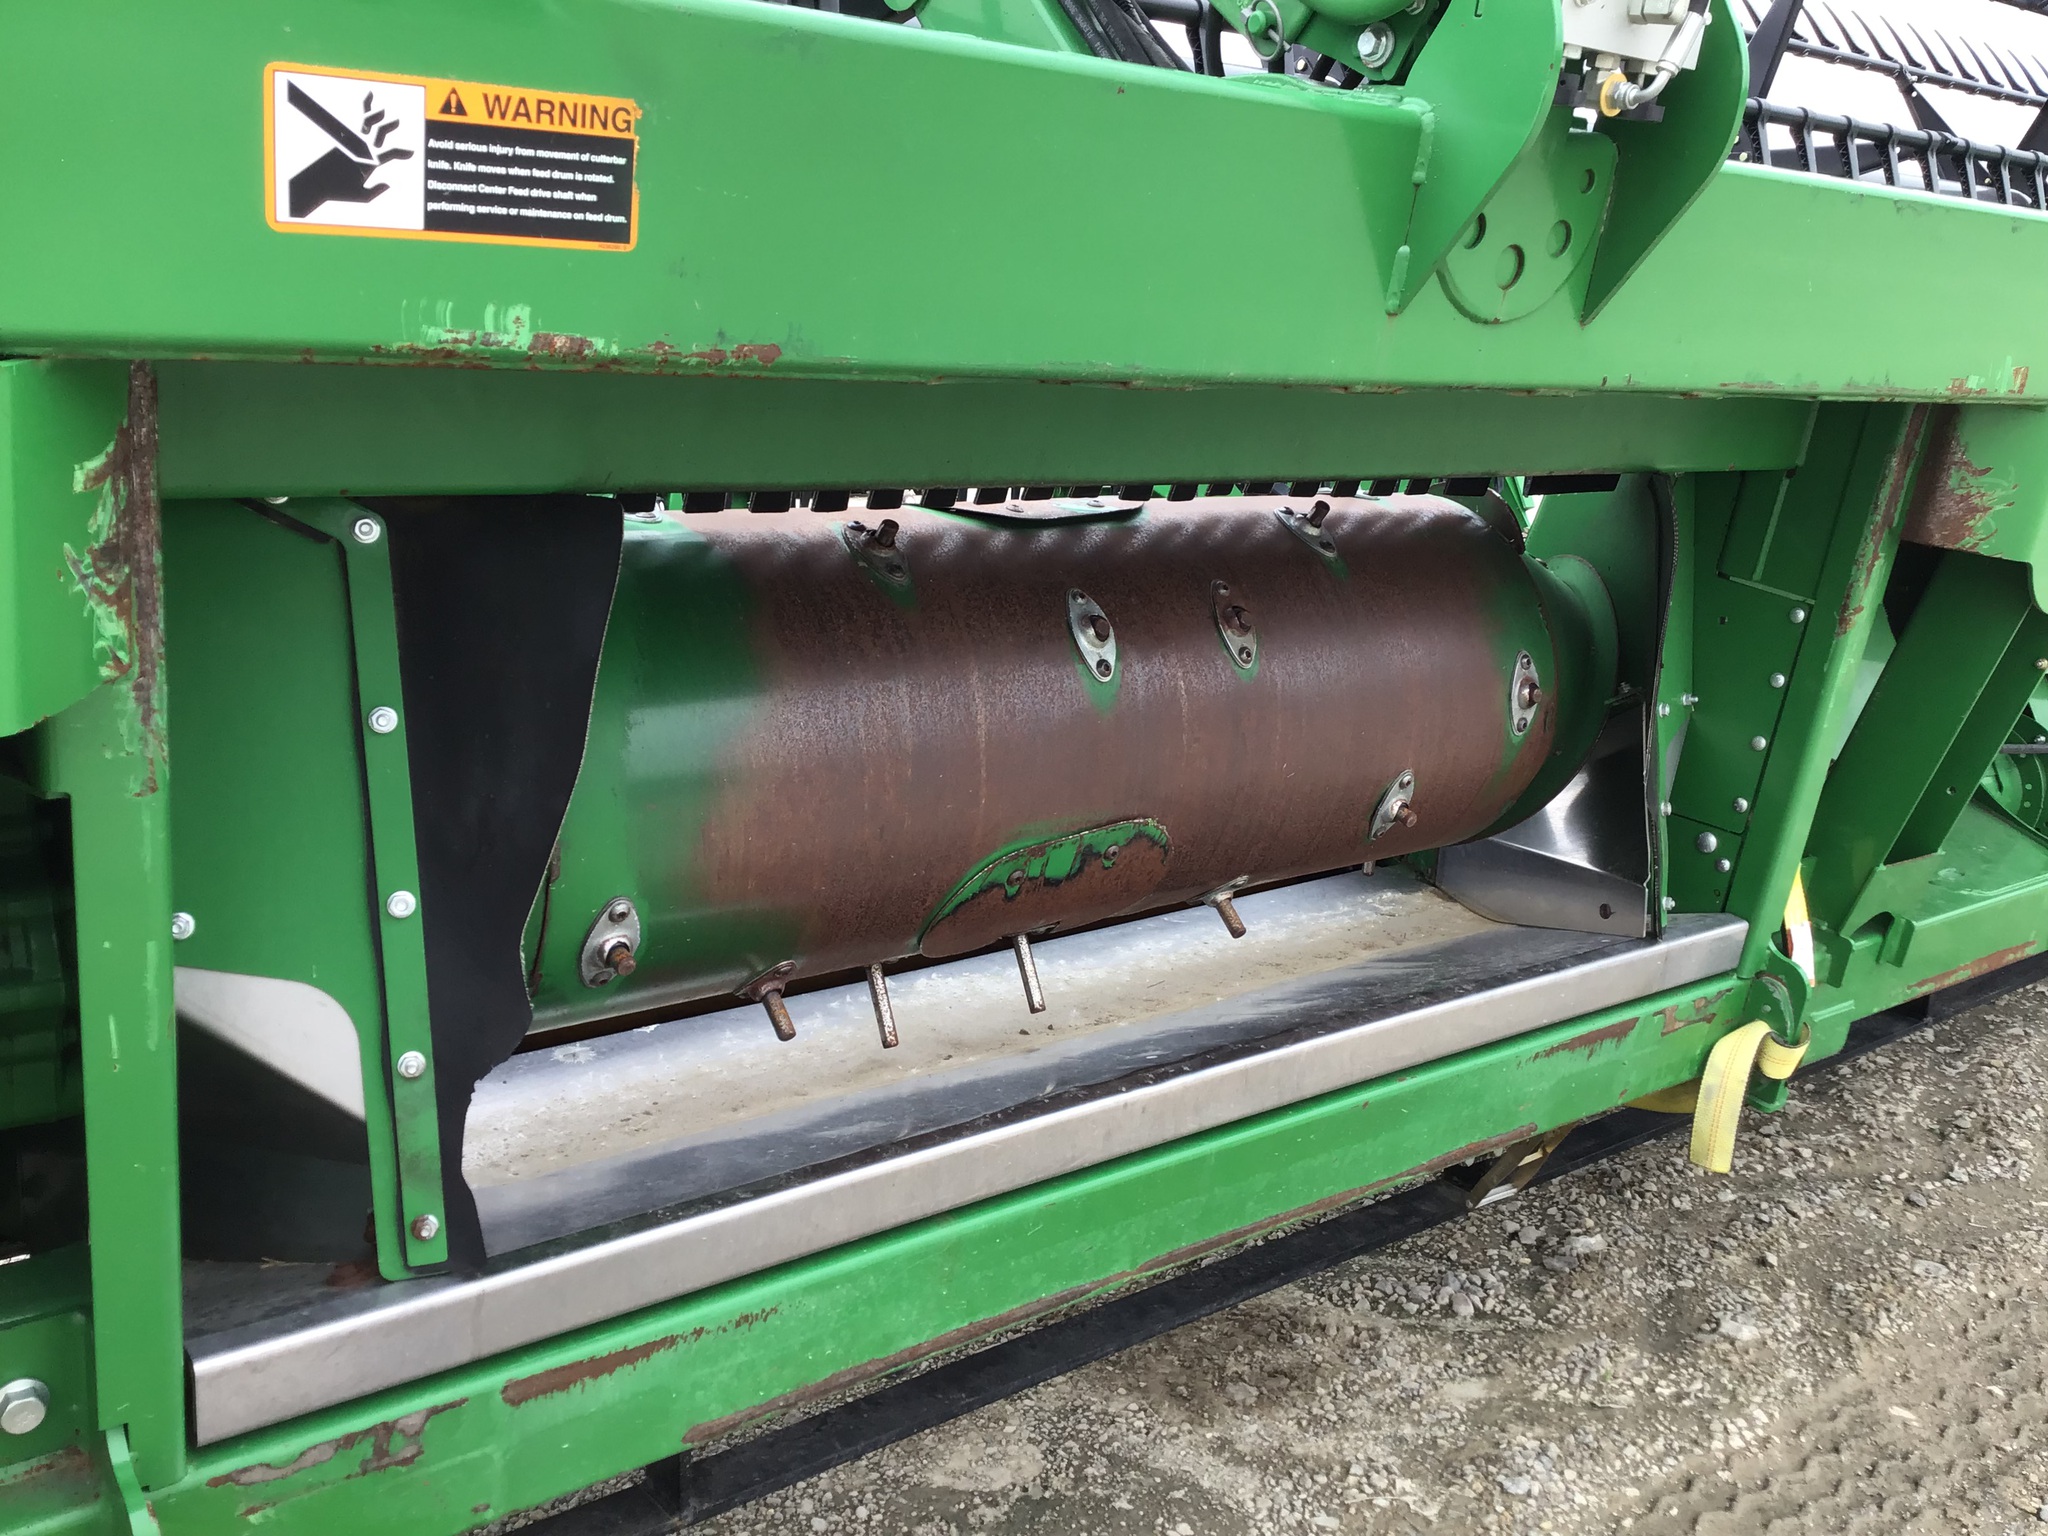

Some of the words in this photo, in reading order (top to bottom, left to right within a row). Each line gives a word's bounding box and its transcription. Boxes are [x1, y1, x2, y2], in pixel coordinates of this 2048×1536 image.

[482, 92, 632, 133] WARNING
[428, 138, 454, 149] Avoid
[455, 142, 488, 152] serious
[489, 144, 514, 156] injury
[515, 146, 535, 156] from
[536, 149, 579, 160] movement
[581, 153, 590, 161] of
[590, 154, 627, 164] cutterbar
[428, 159, 452, 170] knife.
[454, 161, 476, 172] Knife
[478, 165, 506, 174] moves
[508, 166, 531, 176] when
[532, 168, 550, 178] feed
[552, 169, 574, 180] drum
[575, 172, 582, 181] is
[584, 174, 615, 183] rotated.
[427, 180, 477, 192] Disconnect
[478, 184, 507, 194] Center
[508, 186, 529, 196] Feed
[530, 188, 552, 198] drive
[553, 190, 574, 200] shaft
[575, 192, 598, 201] when
[427, 201, 475, 214] performing
[476, 205, 507, 214] service
[520, 208, 572, 219] maintenance
[573, 212, 584, 220] on
[586, 212, 603, 222] feed
[604, 214, 627, 223] drum.
